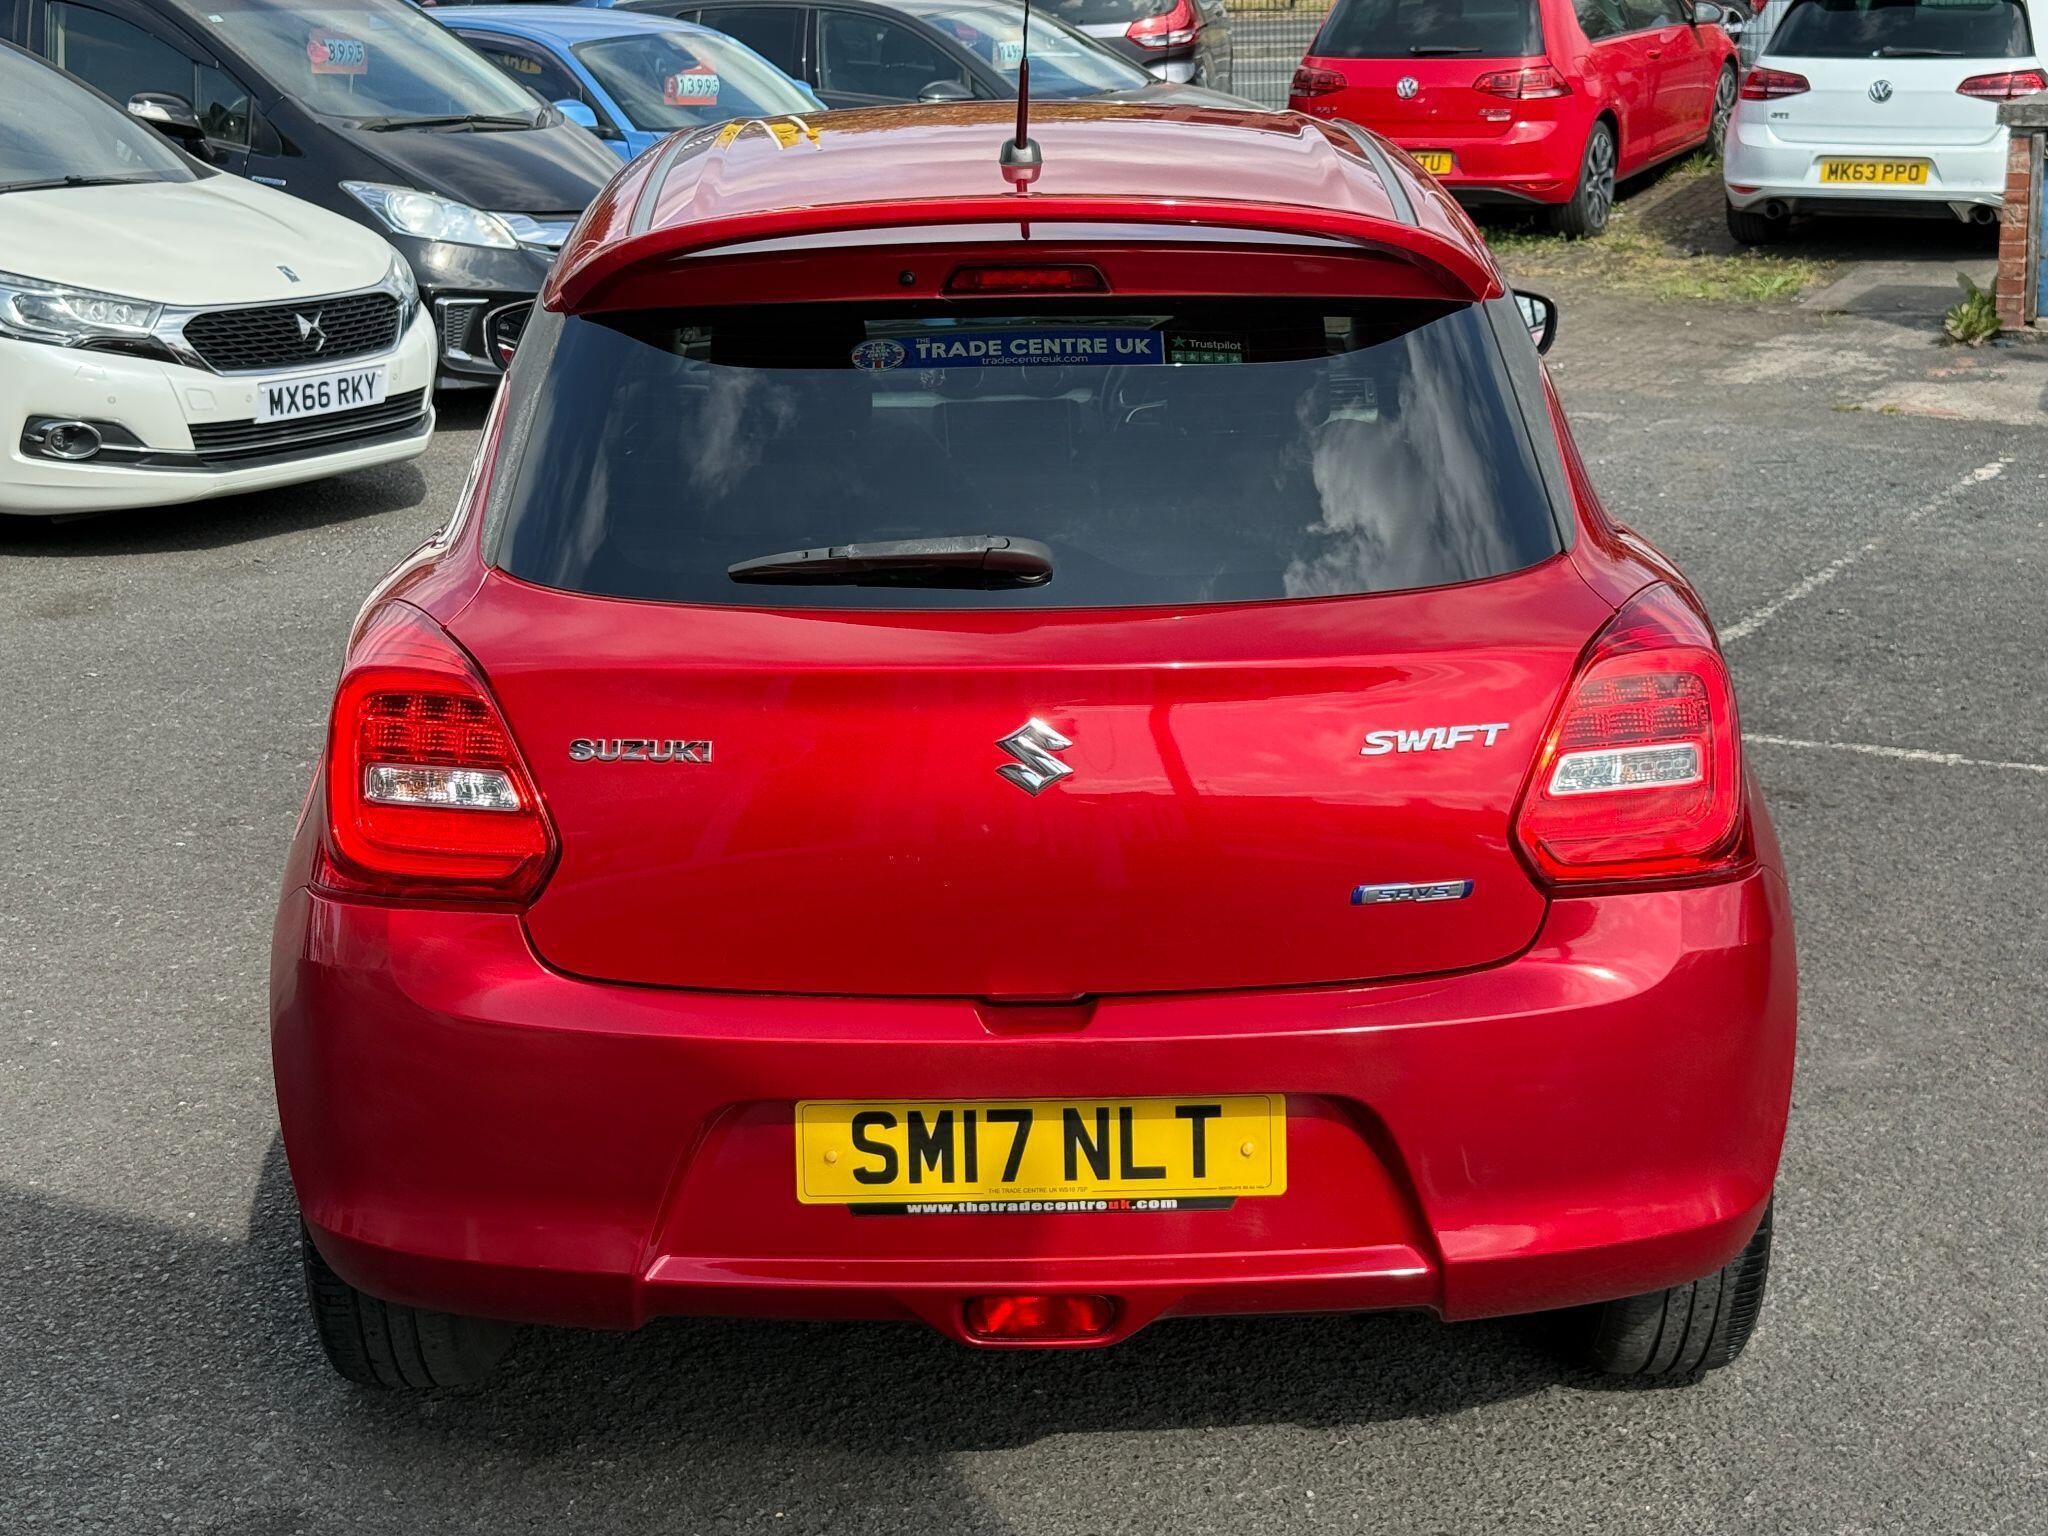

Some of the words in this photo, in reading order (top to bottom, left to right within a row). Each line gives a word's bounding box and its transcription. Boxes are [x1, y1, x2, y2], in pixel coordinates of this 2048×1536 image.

[1827, 162, 1876, 181] MK63
[1882, 163, 1920, 181] PPO
[916, 340, 1002, 359] TRADE
[1009, 338, 1108, 355] CENTRE
[1115, 338, 1152, 354] UK
[1189, 339, 1242, 351] Trustpilot
[981, 354, 1089, 365] tradecentreuk.com
[269, 381, 331, 416] MX66
[337, 372, 376, 405] RKY
[1360, 722, 1509, 755] SWIFT
[569, 738, 713, 763] SUZUKI
[851, 1108, 1033, 1185] SM17
[1063, 1104, 1222, 1182] NLT
[906, 1197, 1178, 1214] www.thetradecentreuk.com
